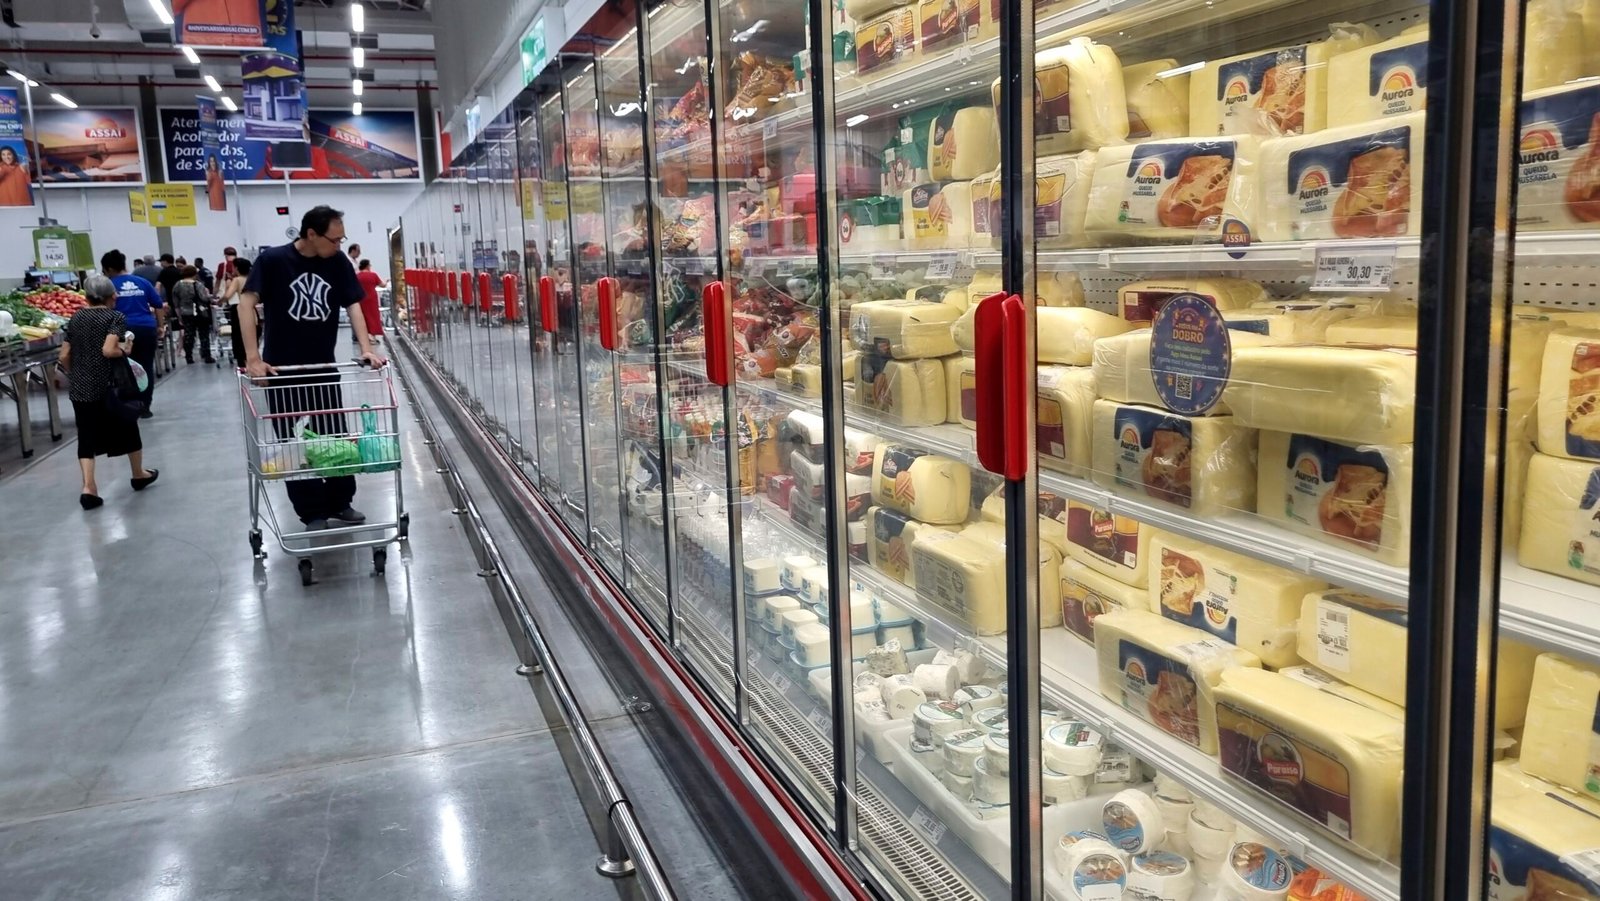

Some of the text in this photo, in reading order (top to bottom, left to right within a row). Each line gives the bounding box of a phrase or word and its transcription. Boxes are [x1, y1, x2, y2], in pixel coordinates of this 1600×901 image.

[1224, 94, 1248, 106] Aurora
[1381, 88, 1414, 101] Aurora
[174, 147, 204, 159] para
[176, 159, 193, 170] de
[1523, 165, 1548, 175] QUEIJO
[1134, 175, 1161, 185] Aurora
[1299, 187, 1329, 201] Aurora
[1347, 266, 1371, 280] 30,30
[288, 272, 332, 322] NY
[1173, 329, 1204, 343] DOBRO
[1120, 440, 1140, 452] Aurora
[1294, 470, 1319, 485] Aurora
